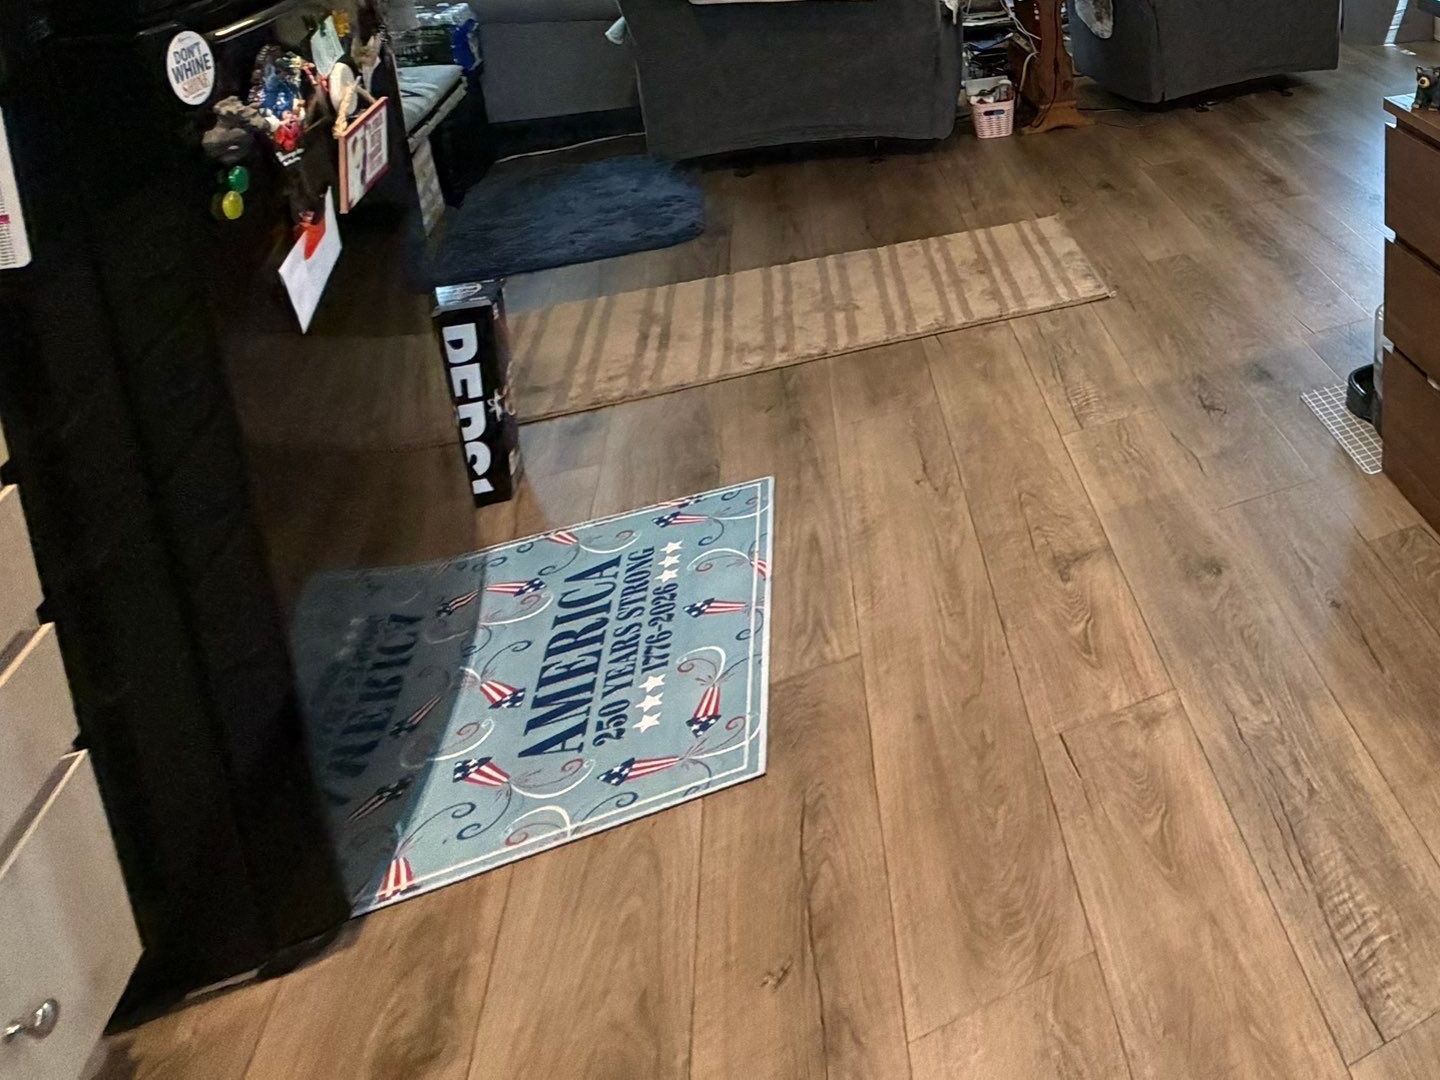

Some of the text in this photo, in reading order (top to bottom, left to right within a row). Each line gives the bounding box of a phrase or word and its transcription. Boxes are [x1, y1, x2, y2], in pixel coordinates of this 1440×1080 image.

[171, 53, 212, 84] WHINE
[518, 555, 623, 758] AMERICA
[592, 546, 655, 747] 250 YEARS STRONG
[641, 582, 679, 674] 1776-2026
